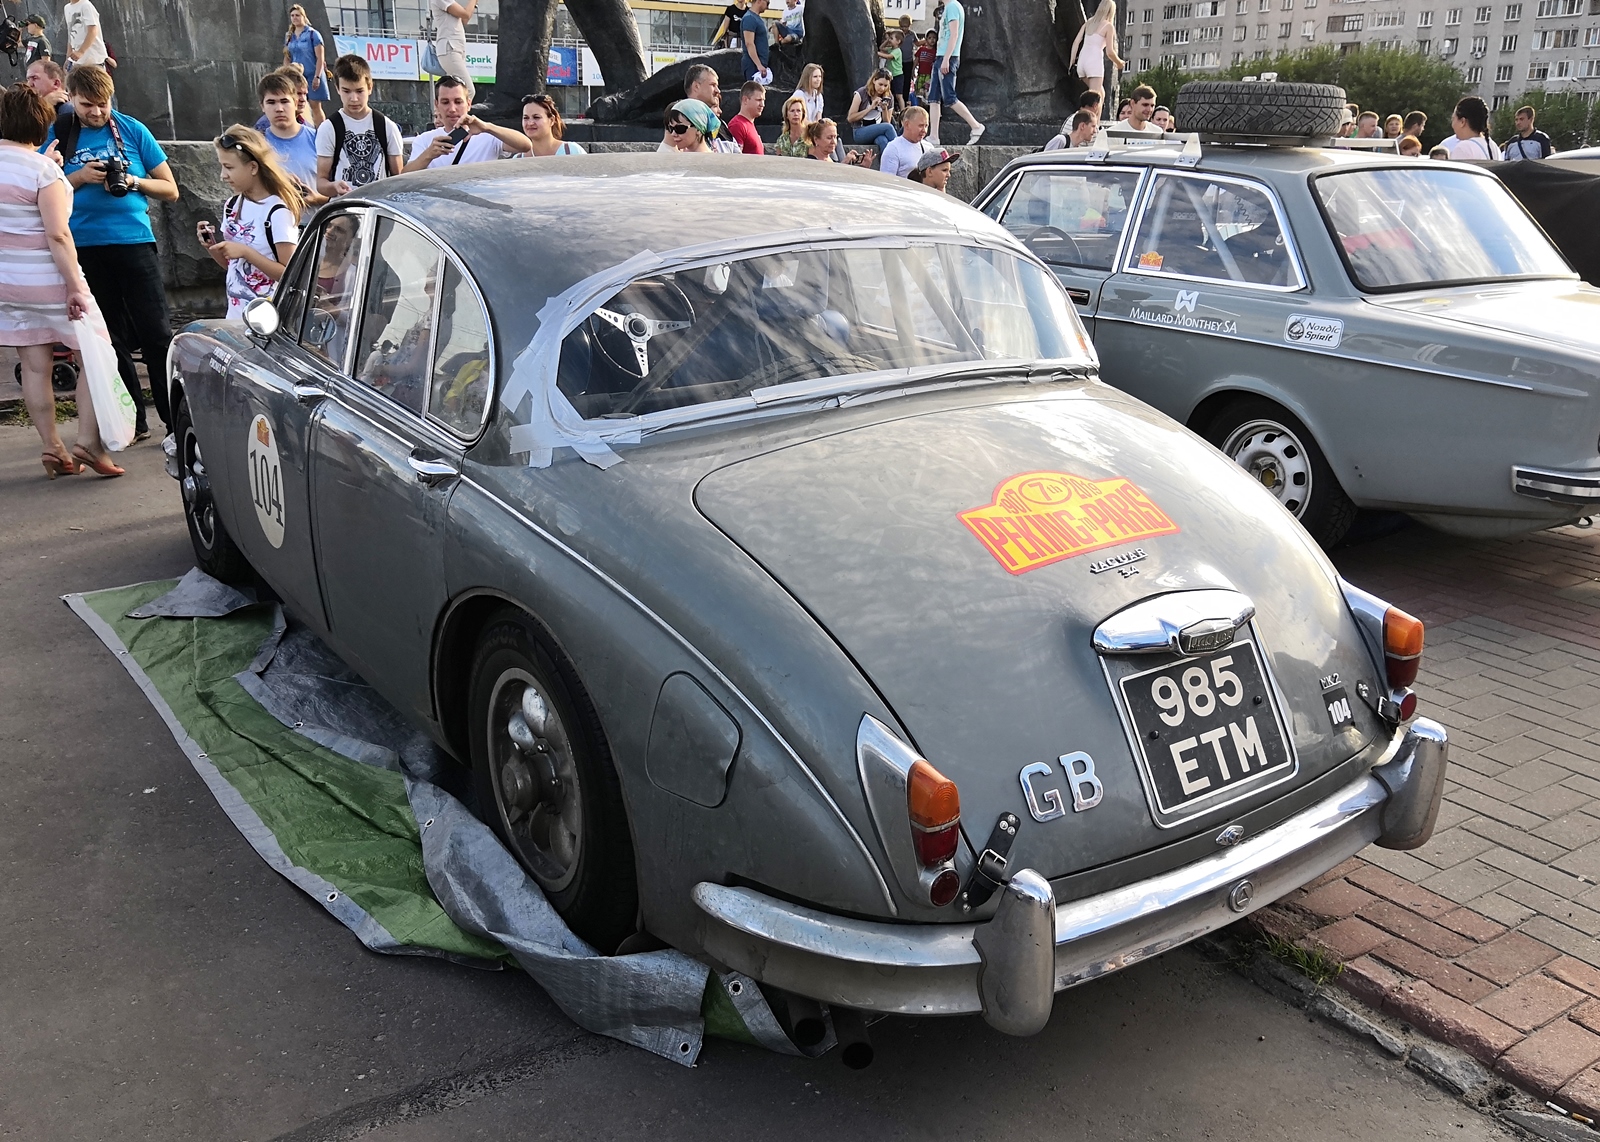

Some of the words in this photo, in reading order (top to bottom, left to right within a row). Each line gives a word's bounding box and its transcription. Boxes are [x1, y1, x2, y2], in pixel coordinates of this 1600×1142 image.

[366, 42, 413, 63] МРТ
[465, 54, 492, 65] Spark
[1223, 320, 1238, 334] SA
[1304, 331, 1334, 343] Spirit
[1306, 322, 1341, 335] Nordic
[250, 449, 284, 528] 104
[1061, 477, 1102, 500] 2019
[1079, 483, 1173, 538] PARIS
[969, 509, 1099, 567] PEKING
[1078, 517, 1099, 532] TO
[1089, 548, 1149, 575] JAGUAR
[1151, 655, 1244, 727] 985
[1327, 697, 1352, 725] 104
[1169, 715, 1268, 796] ETM
[1019, 750, 1104, 823] GB
